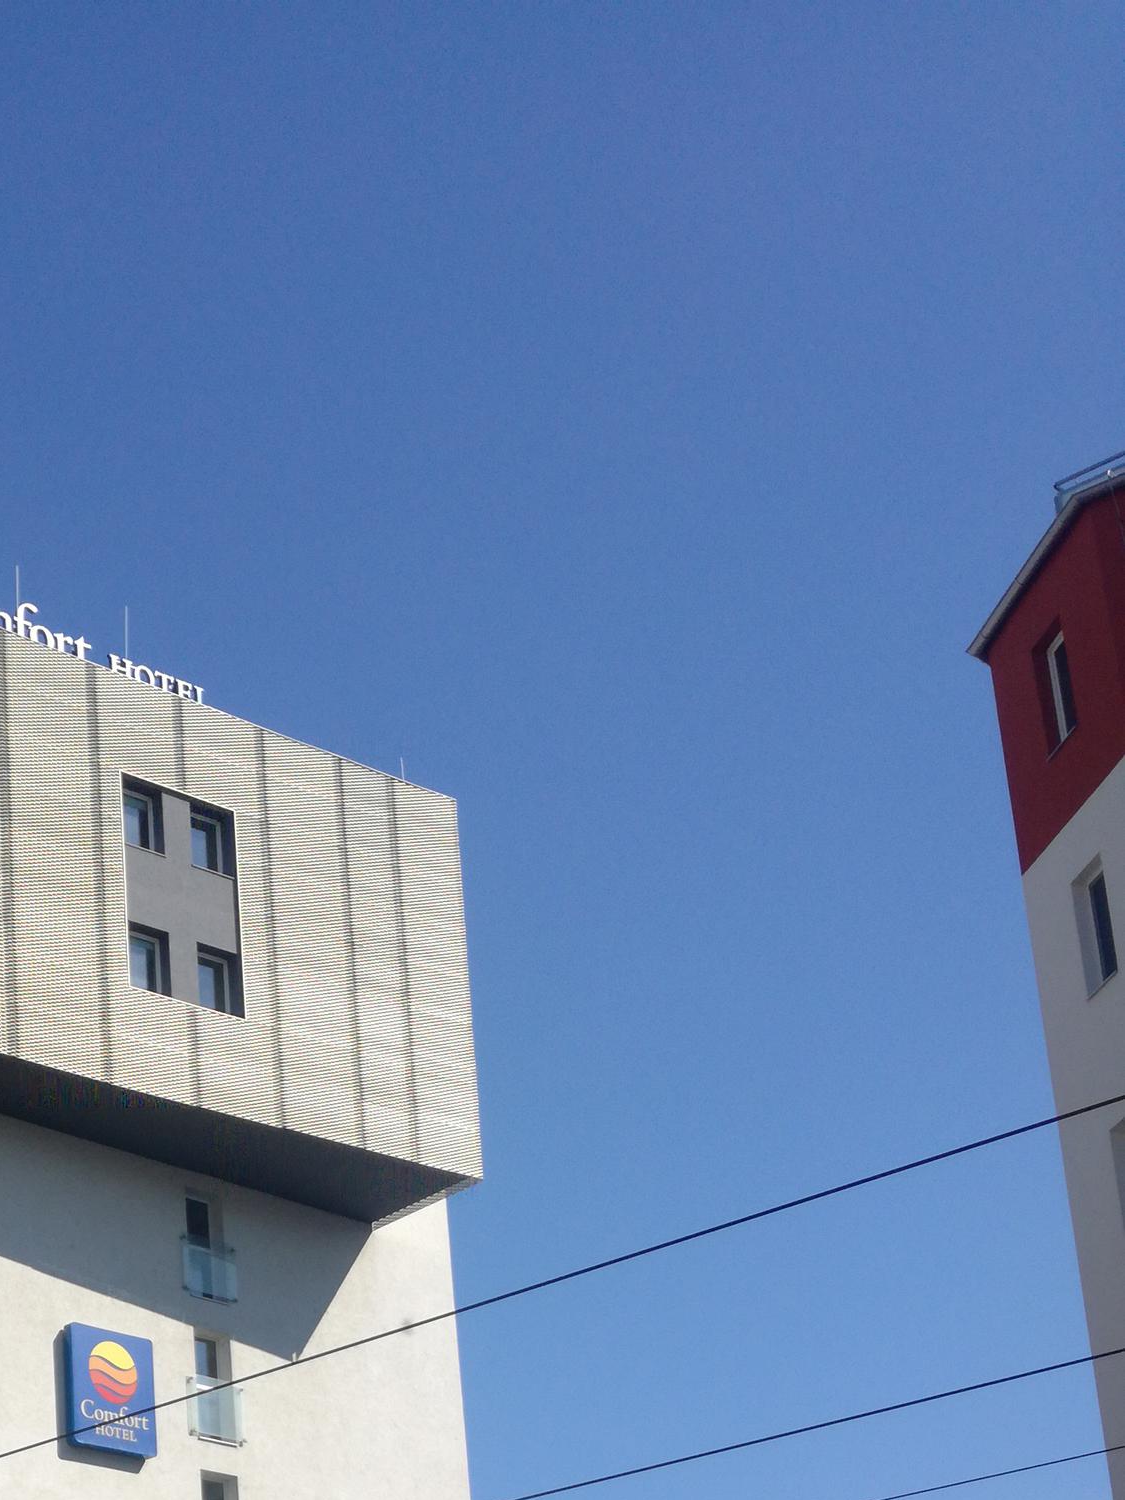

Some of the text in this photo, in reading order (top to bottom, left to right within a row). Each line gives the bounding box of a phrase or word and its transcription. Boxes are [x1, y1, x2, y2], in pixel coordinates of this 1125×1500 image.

[107, 653, 205, 704] HOTEL
[80, 1398, 149, 1430] Comfort
[95, 1424, 137, 1442] HOTEL
